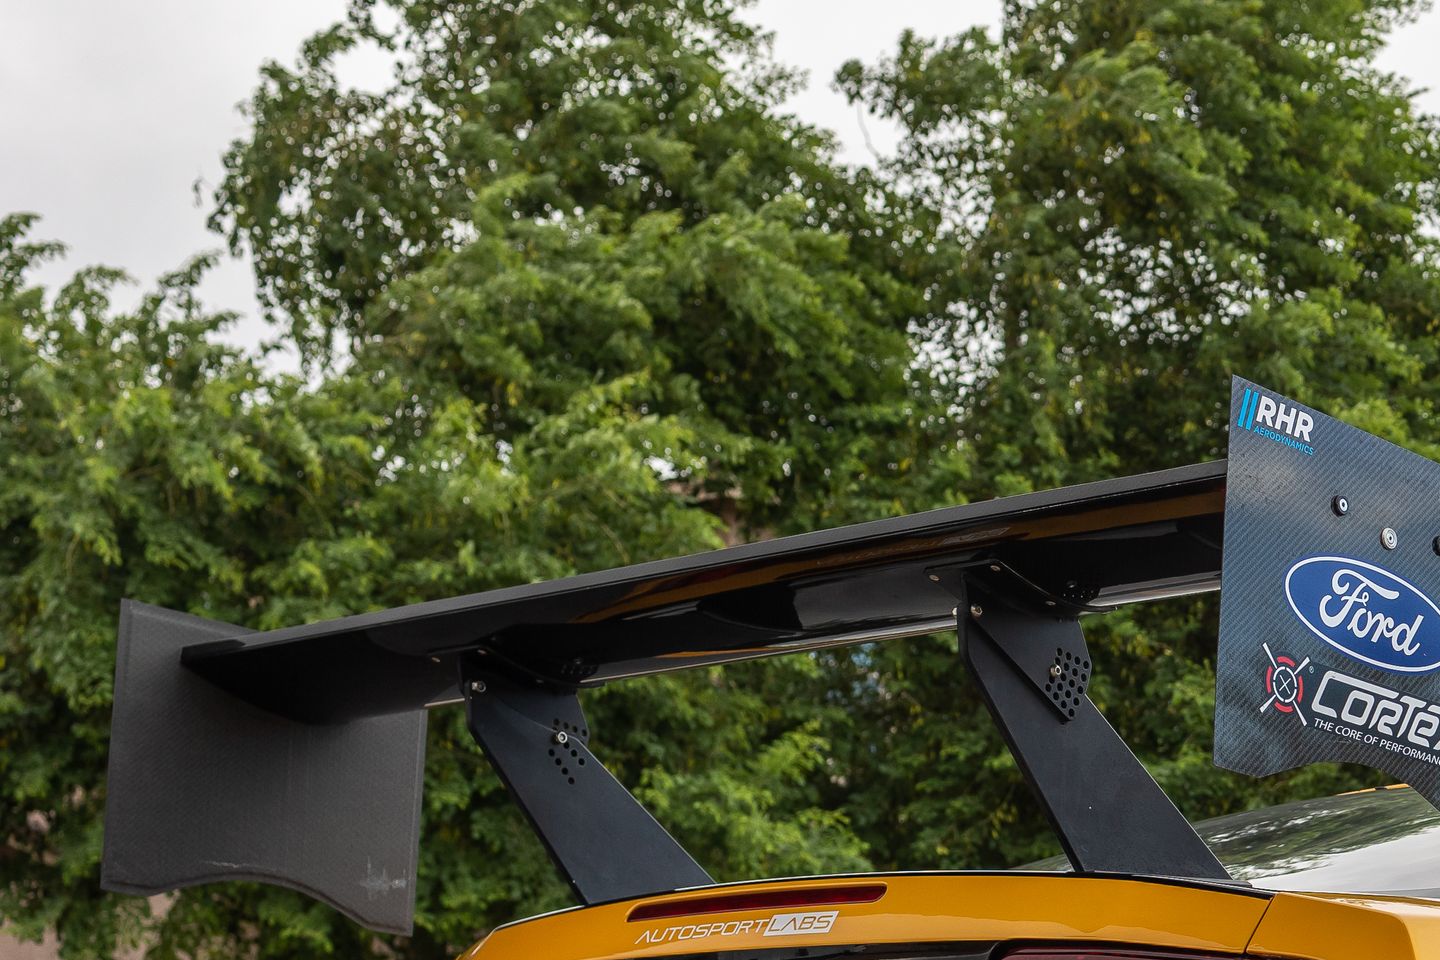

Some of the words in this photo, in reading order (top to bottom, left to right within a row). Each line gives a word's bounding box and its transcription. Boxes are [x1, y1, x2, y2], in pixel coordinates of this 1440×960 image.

[1256, 395, 1314, 442] RHR
[1253, 425, 1315, 456] AERODYNAMICS
[1319, 568, 1425, 656] Ford
[1314, 717, 1334, 733] THE
[1335, 724, 1363, 742] CORE
[1363, 734, 1380, 750] OF
